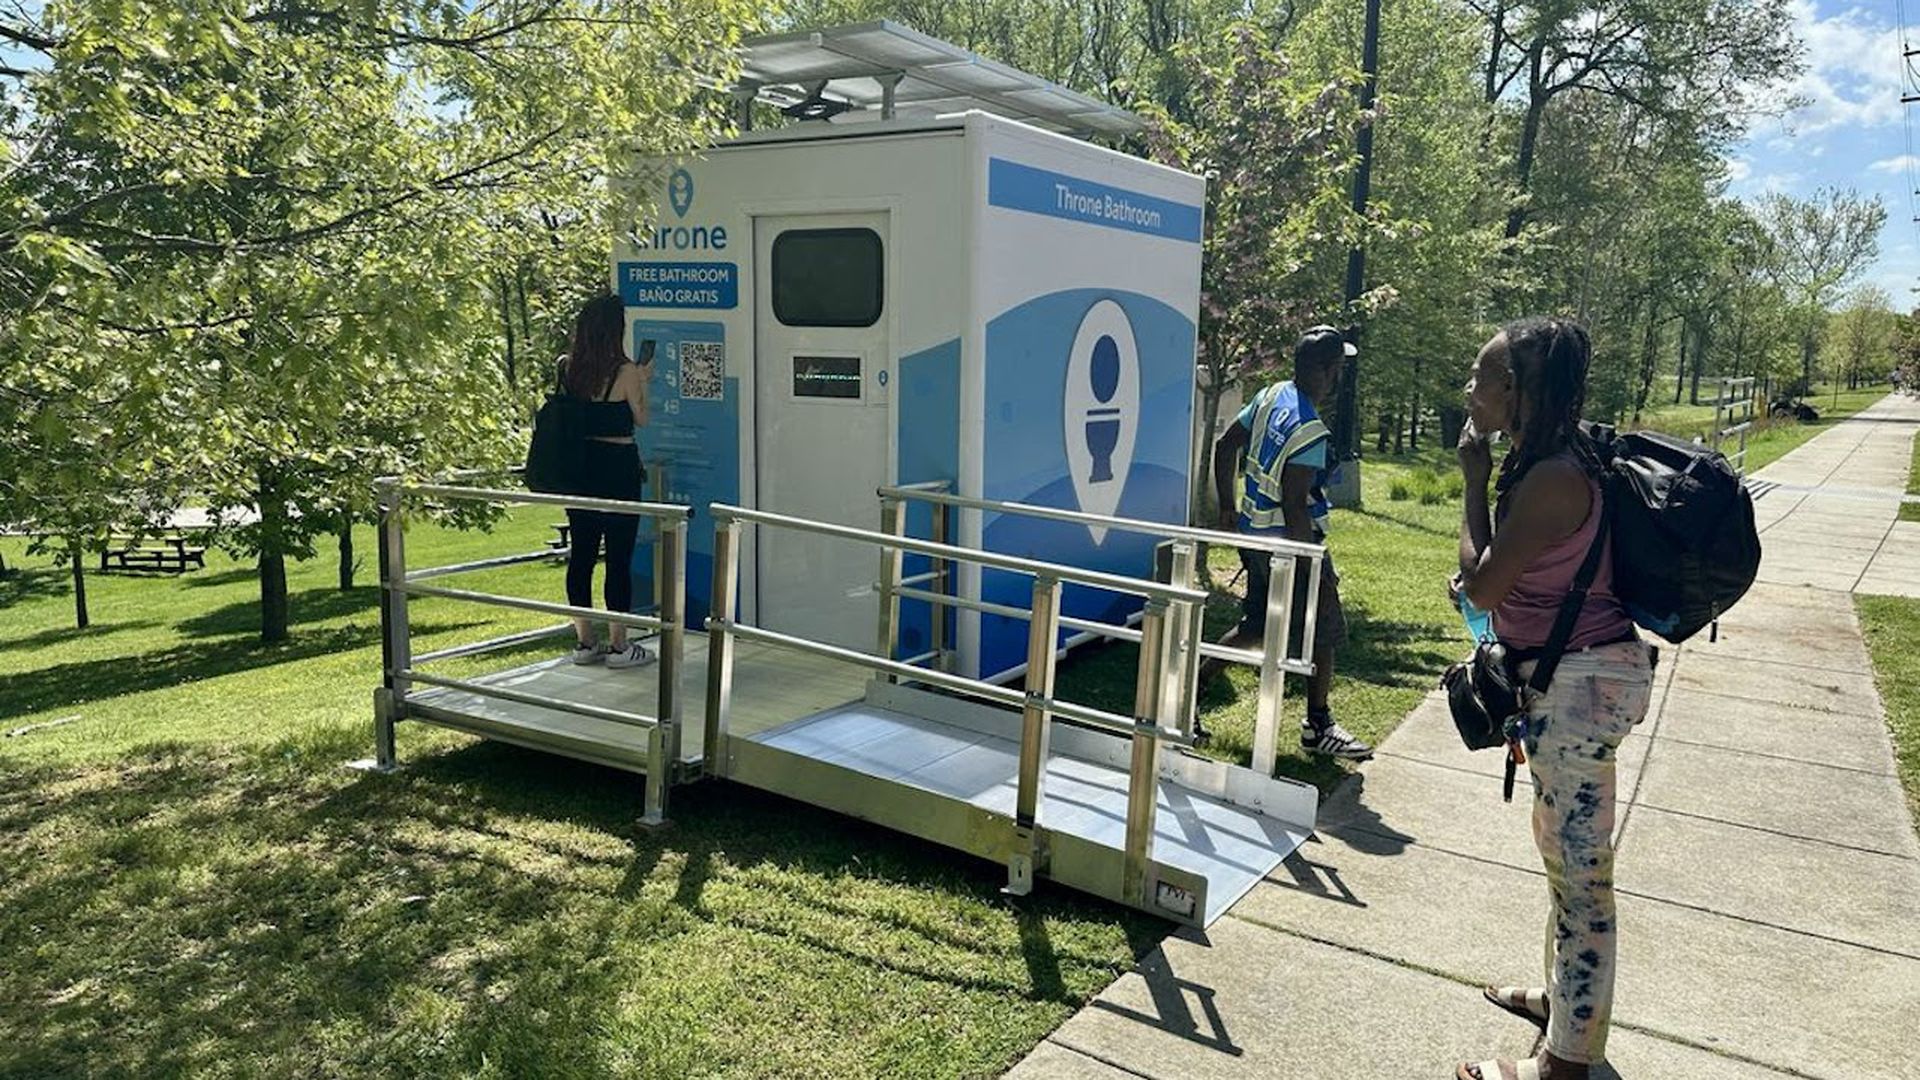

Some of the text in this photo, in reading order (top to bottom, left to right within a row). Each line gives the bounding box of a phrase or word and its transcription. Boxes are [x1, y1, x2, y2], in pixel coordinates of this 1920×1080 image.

[1055, 184, 1161, 228] Throne Bathroom
[629, 219, 728, 250] rone
[629, 268, 729, 283] FREE BATHROOM
[639, 285, 719, 303] BAÑO GRATIS
